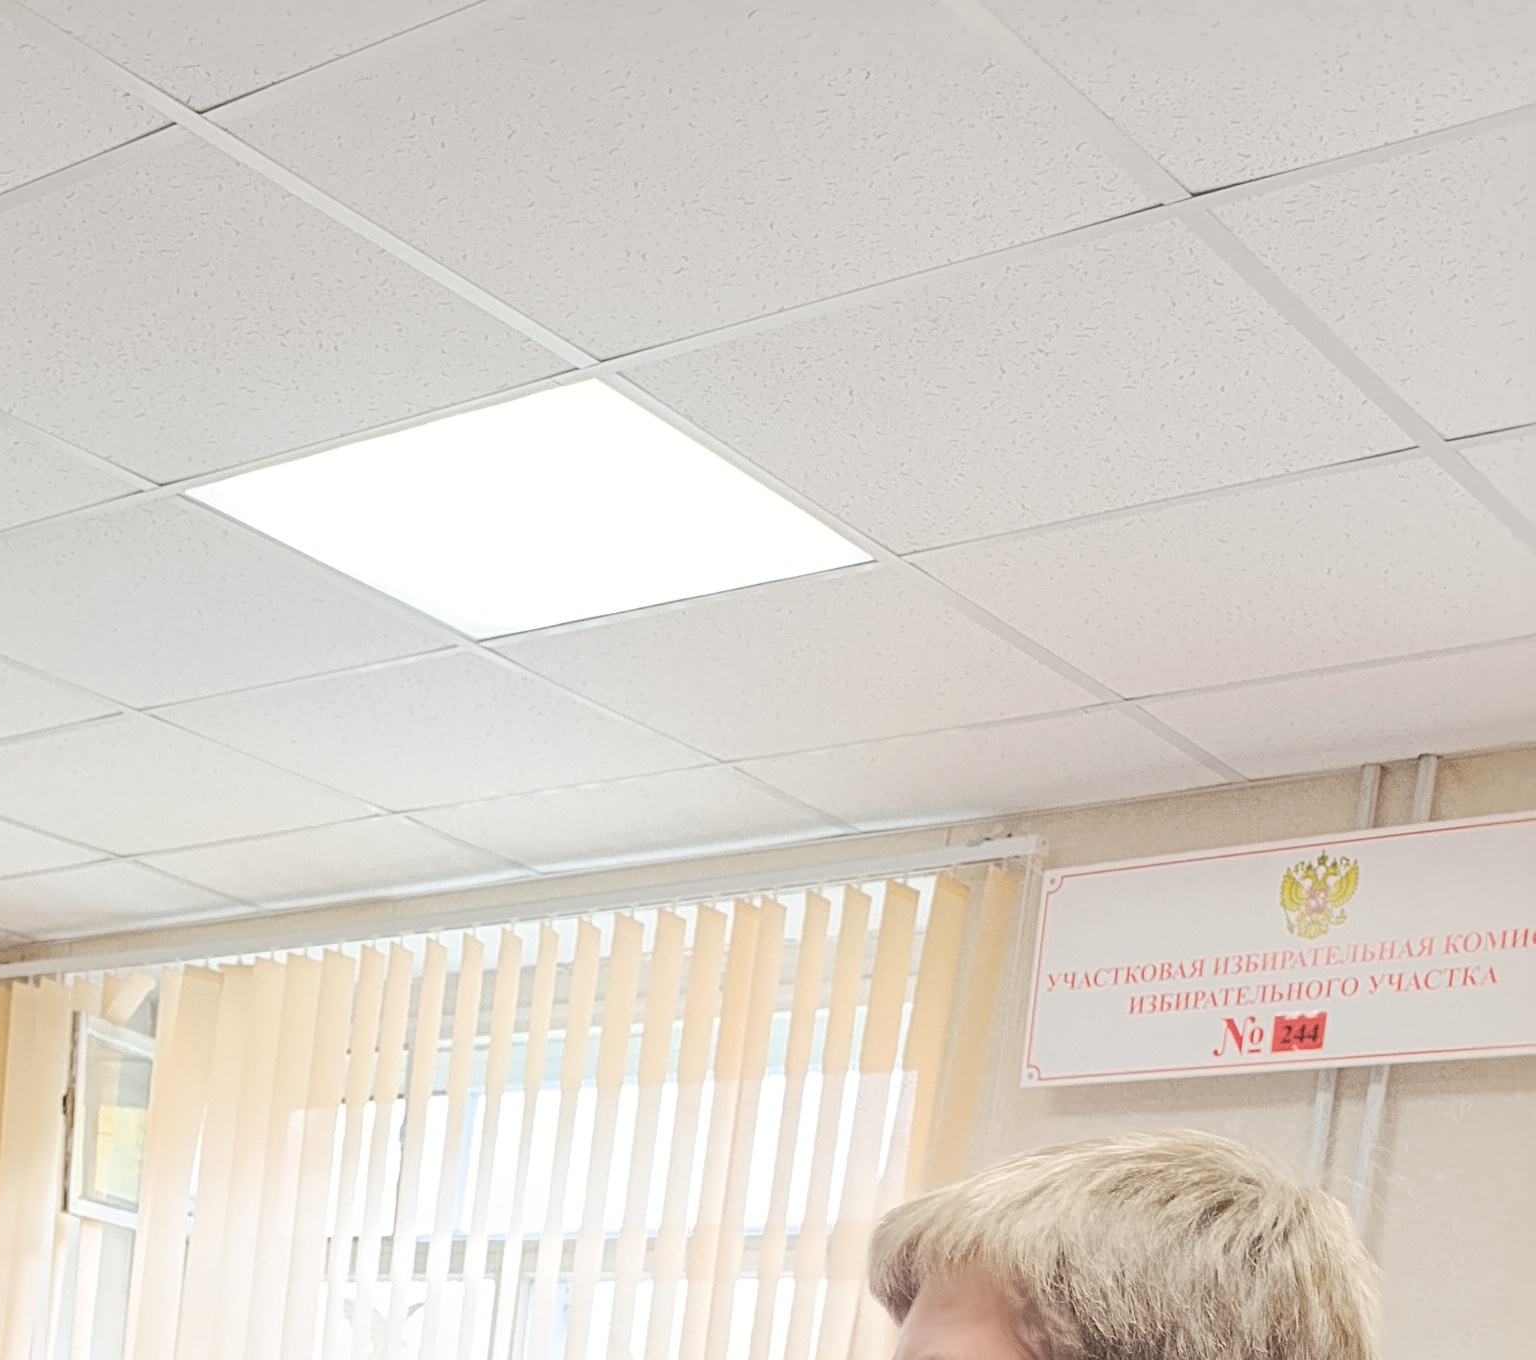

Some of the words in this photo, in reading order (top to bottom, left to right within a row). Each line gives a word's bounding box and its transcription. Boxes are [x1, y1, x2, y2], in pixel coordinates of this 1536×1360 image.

[1047, 957, 1207, 993] УЧАСТКОВАЯ
[1213, 936, 1436, 976] ИЗБИРАТЕЛЬНАЯ
[1444, 927, 1536, 955] КОМИ
[1128, 975, 1360, 1015] ИЗБИРАТЕЛЬНОГО
[1368, 964, 1498, 995] УЧАСТКА
[1212, 1015, 1264, 1056] №
[1281, 1023, 1319, 1044] 244
